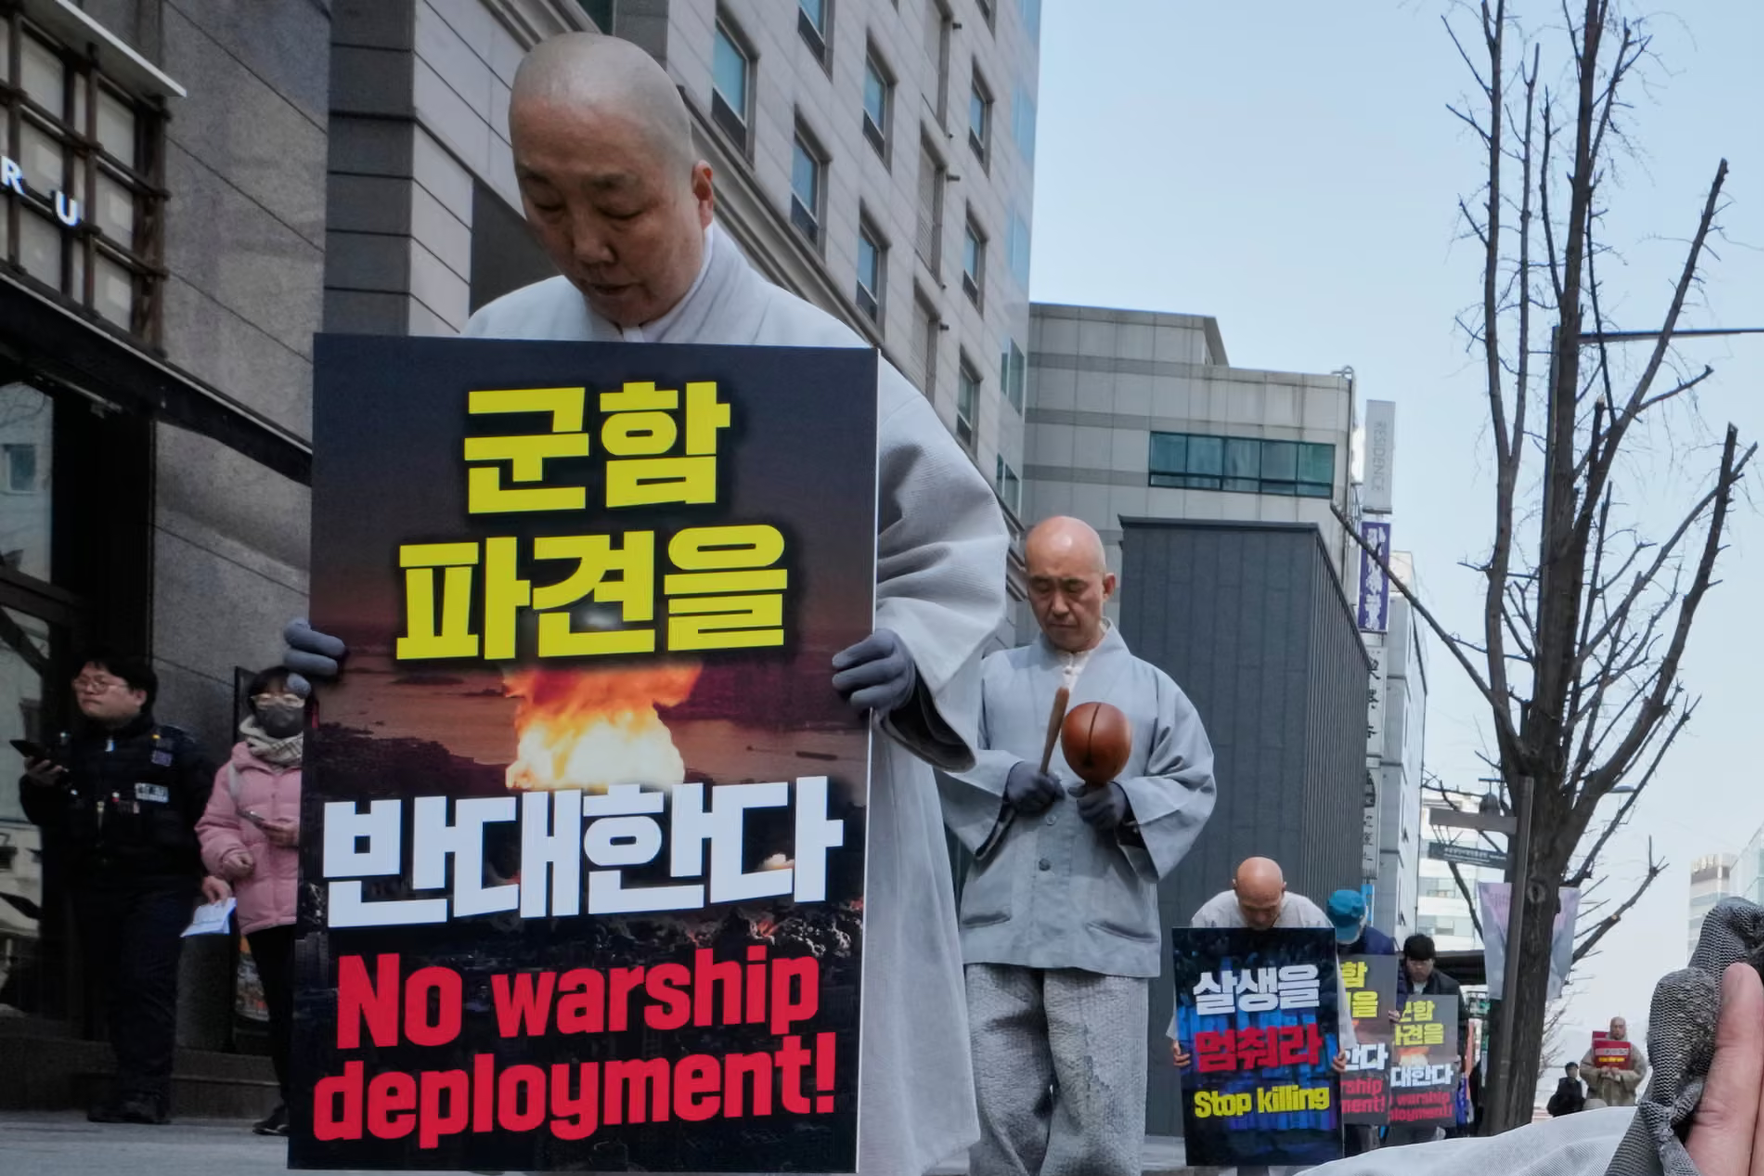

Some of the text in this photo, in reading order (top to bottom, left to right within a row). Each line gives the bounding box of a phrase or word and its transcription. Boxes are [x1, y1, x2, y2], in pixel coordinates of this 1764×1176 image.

[463, 380, 731, 515] 군함
[396, 523, 788, 661] 파견을
[322, 774, 845, 928] 반대한다
[335, 943, 821, 1050] No warship
[1193, 964, 1320, 1015] 살생을
[312, 1031, 837, 1150] deployment!
[1194, 1023, 1325, 1073] 멈춰라
[1194, 1084, 1330, 1118] Stop killing
